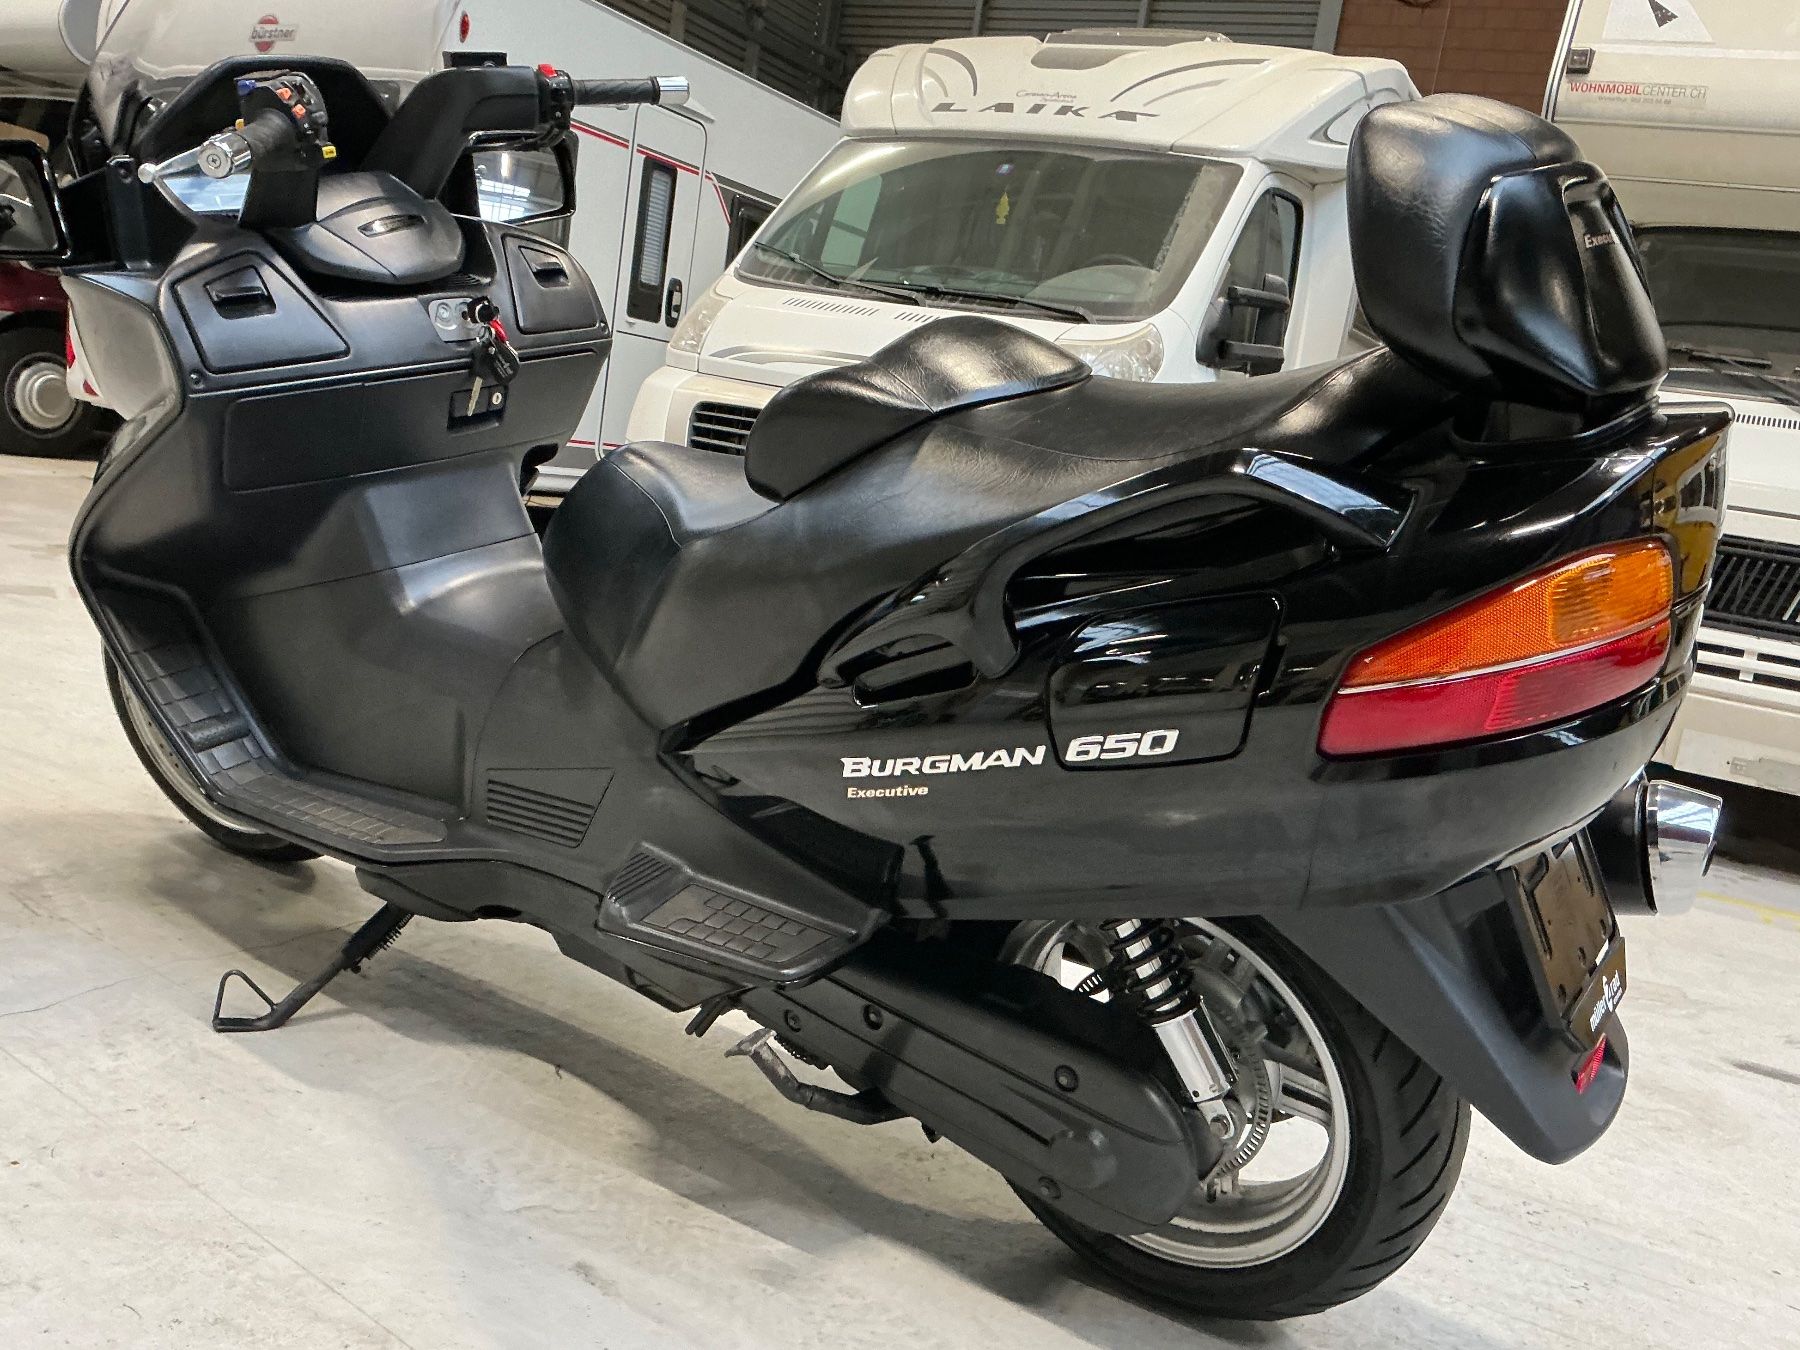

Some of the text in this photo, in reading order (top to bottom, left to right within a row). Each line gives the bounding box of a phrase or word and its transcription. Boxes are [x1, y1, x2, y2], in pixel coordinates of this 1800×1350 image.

[931, 102, 1160, 122] LAIKA
[1065, 729, 1180, 762] 650
[847, 785, 929, 798] Executive
